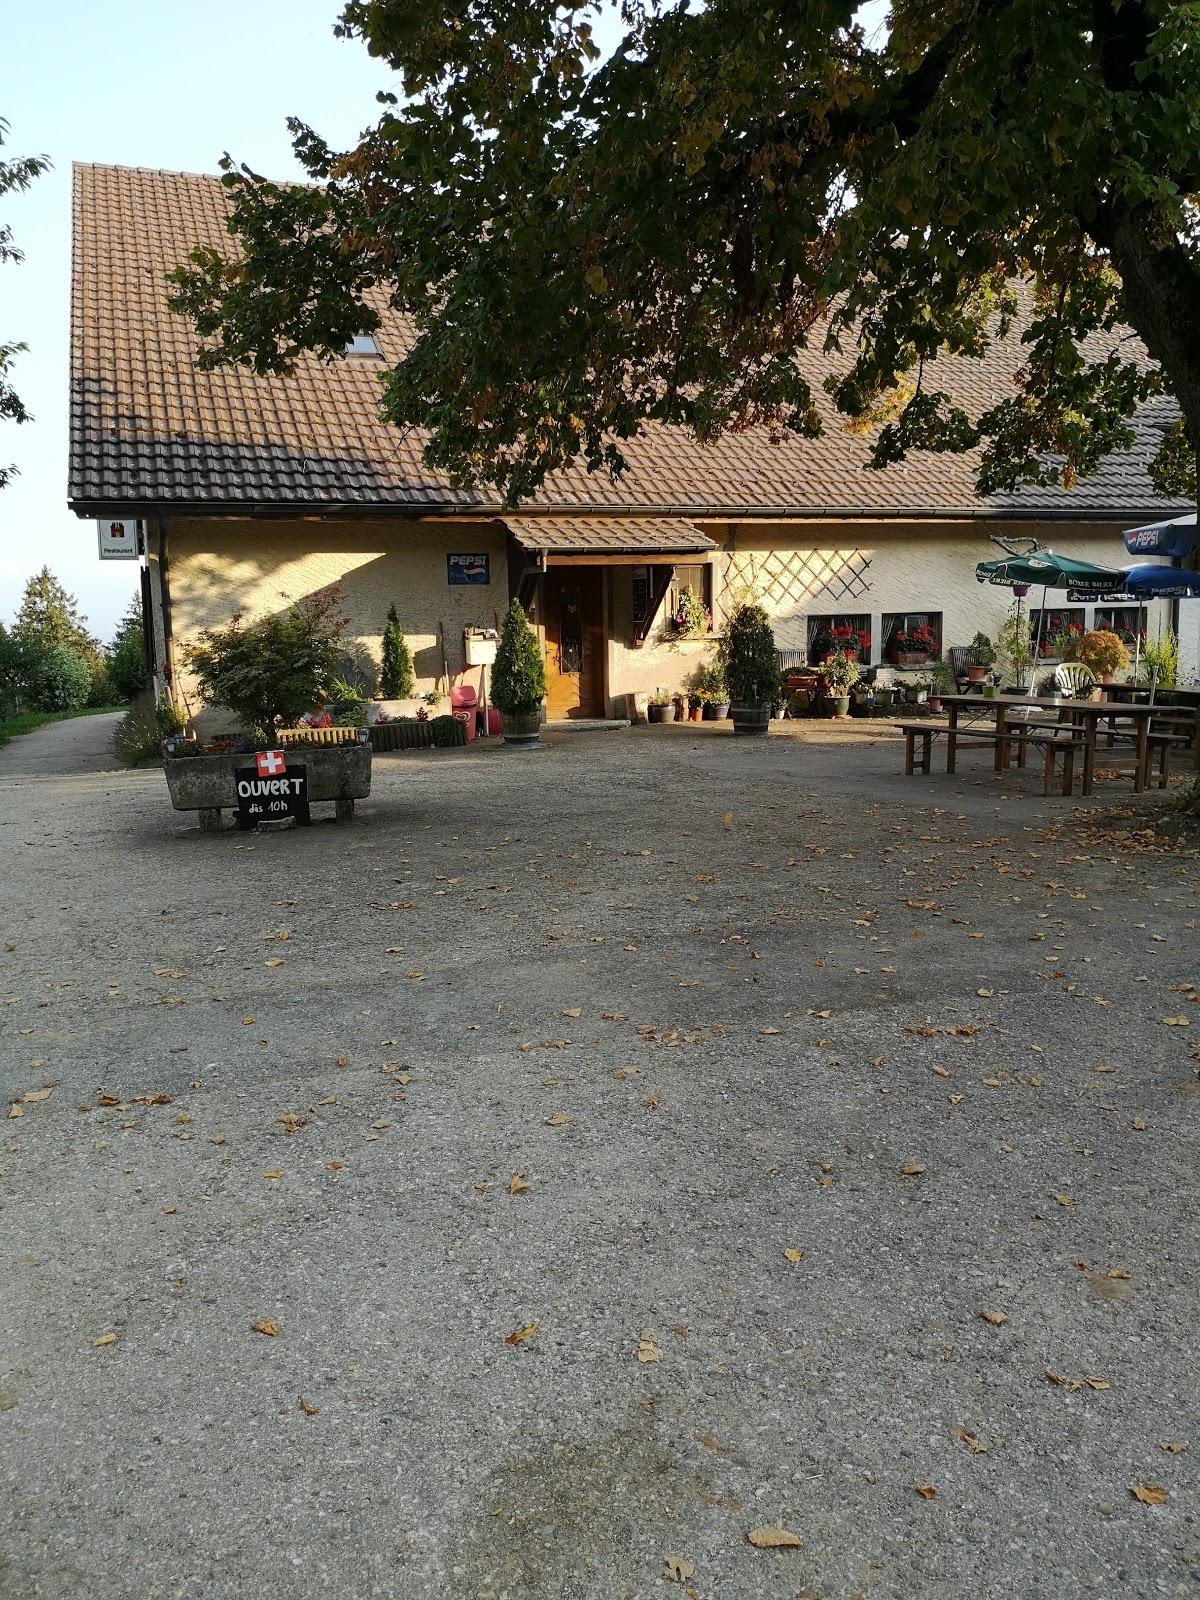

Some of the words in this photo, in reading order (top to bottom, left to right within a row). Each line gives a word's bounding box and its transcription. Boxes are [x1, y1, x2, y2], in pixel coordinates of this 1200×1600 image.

[1136, 531, 1159, 547] PEPSI
[450, 555, 487, 566] PEPSI
[1068, 579, 1090, 587] BOXER
[1150, 585, 1187, 596] PEPSI
[248, 803, 264, 814] dès
[267, 799, 288, 812] 10h
